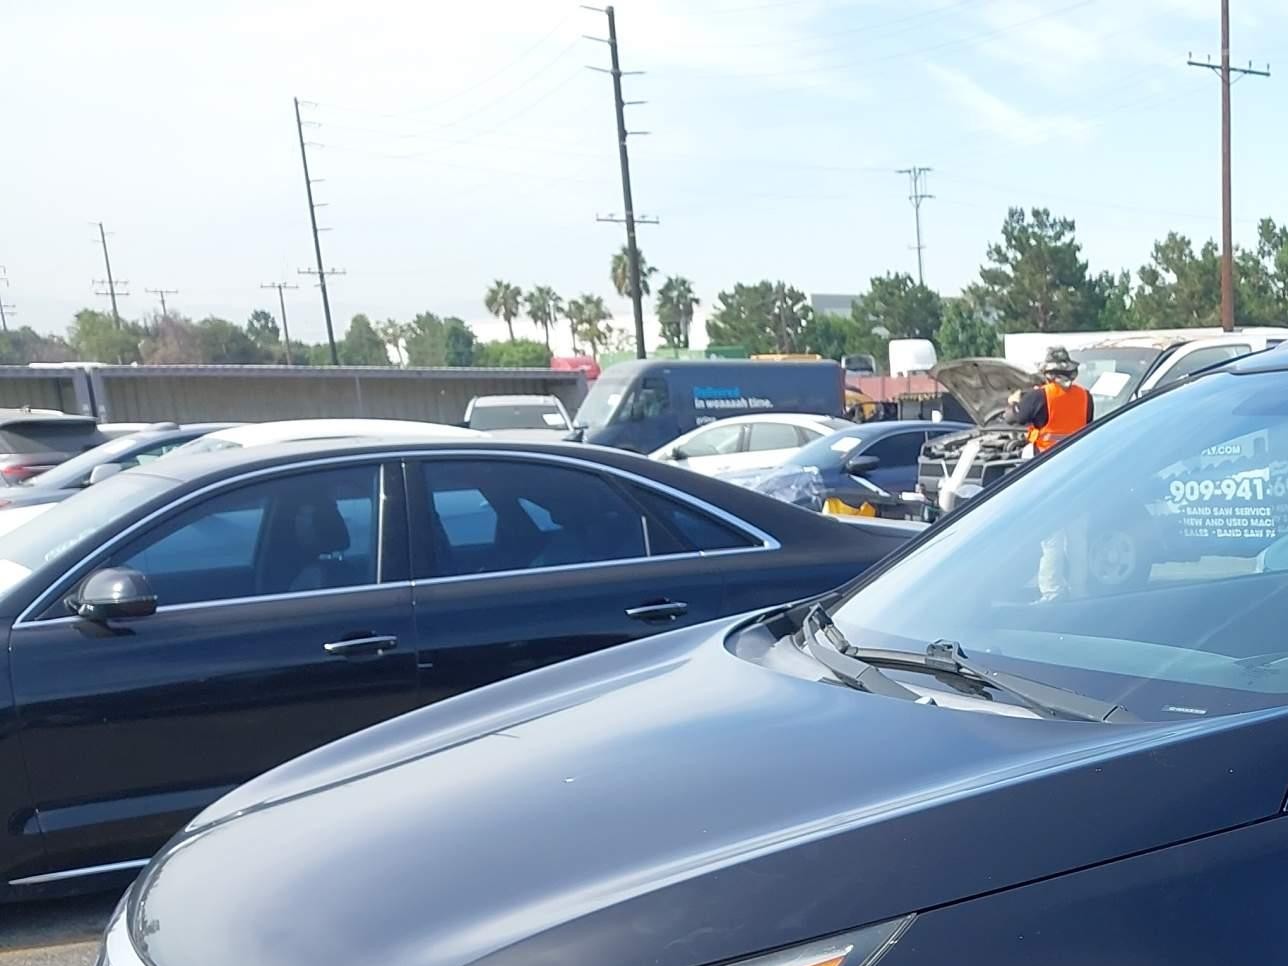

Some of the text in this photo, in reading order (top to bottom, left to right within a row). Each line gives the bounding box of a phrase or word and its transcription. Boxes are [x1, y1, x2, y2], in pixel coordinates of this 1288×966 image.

[1187, 507, 1211, 516] BAND
[1213, 507, 1233, 516] SAW
[1205, 518, 1224, 526] AND
[1226, 518, 1249, 527] USED
